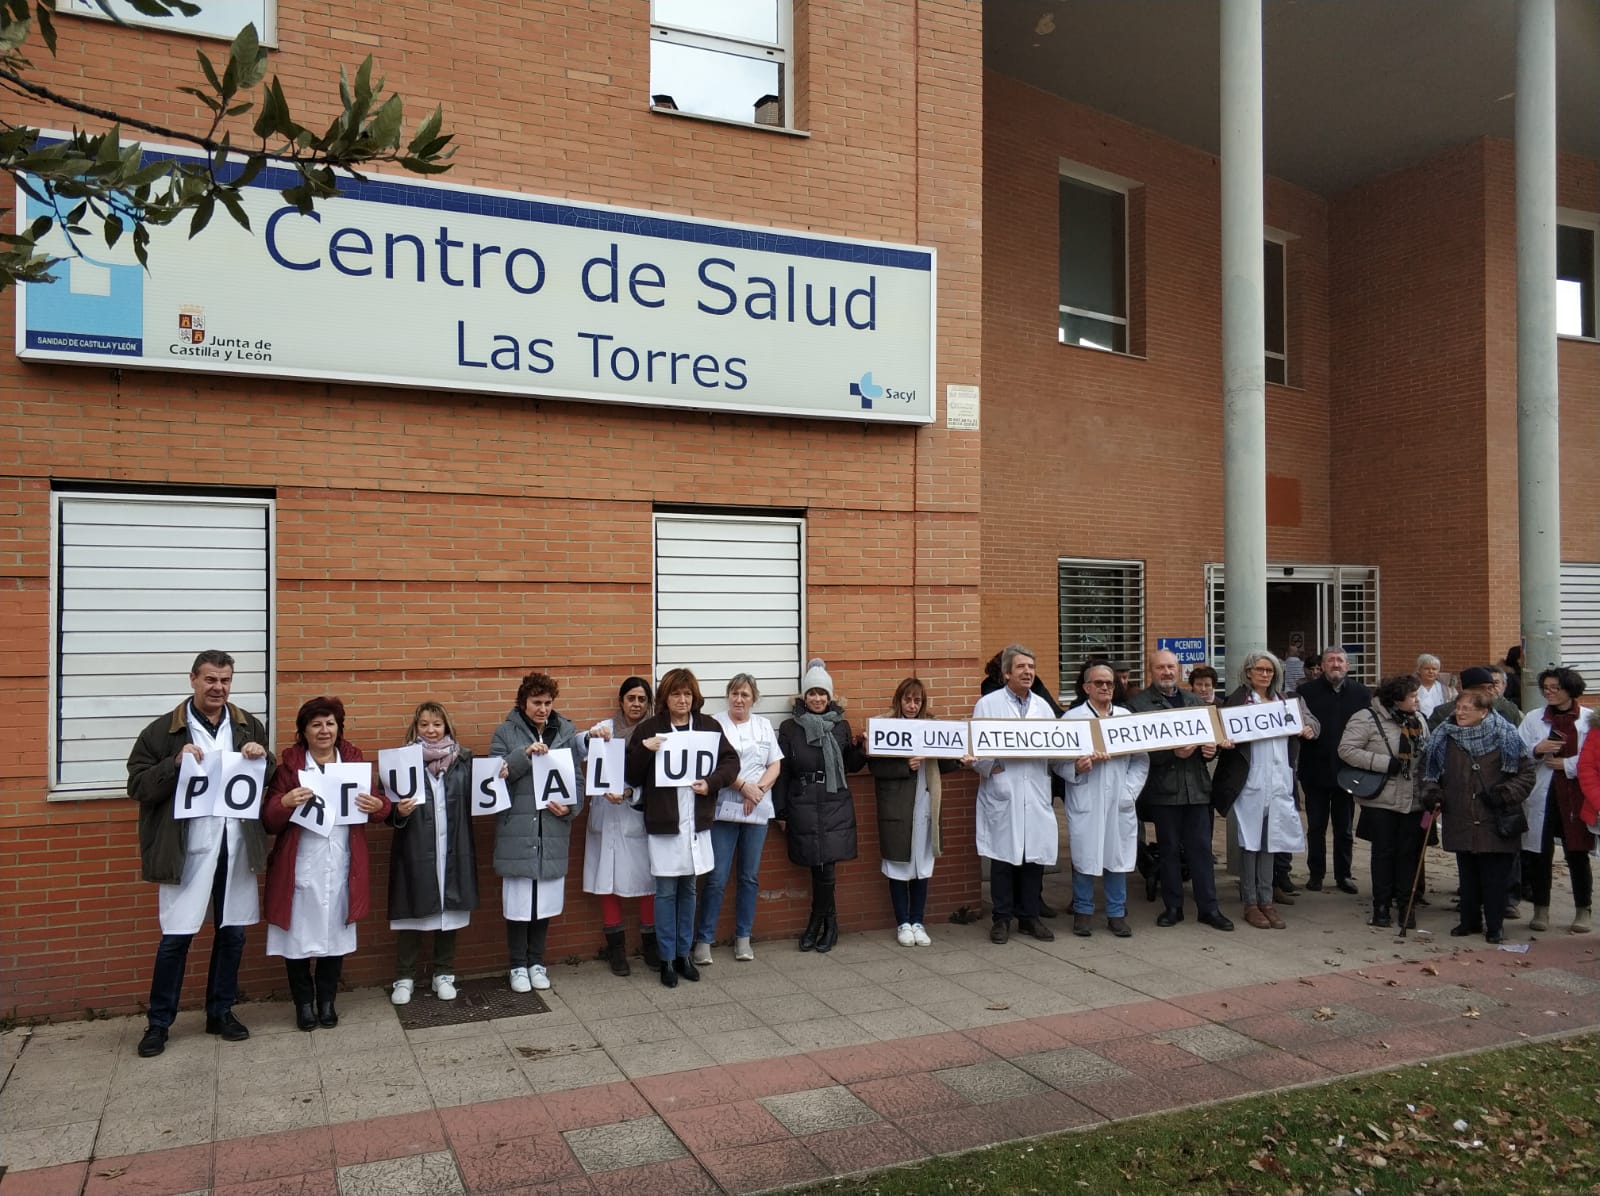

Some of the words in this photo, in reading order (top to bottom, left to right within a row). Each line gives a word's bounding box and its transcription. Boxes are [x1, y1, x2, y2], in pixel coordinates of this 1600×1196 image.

[265, 206, 546, 295] Centro
[581, 244, 666, 308] de
[697, 258, 877, 331] Salud
[37, 336, 68, 346] SANIDAD
[68, 338, 79, 347] DE
[79, 339, 111, 349] CASTILLA
[110, 342, 117, 350] Y
[117, 342, 137, 351] LEÓN
[209, 335, 250, 348] Junta
[254, 339, 272, 351] de
[169, 344, 220, 358] Castilla
[224, 350, 233, 361] y
[237, 349, 272, 361] León
[458, 320, 554, 374] Las
[578, 331, 748, 390] Torres
[886, 388, 916, 403] Sacyl
[1178, 640, 1202, 650] CENTRO
[1175, 652, 1185, 662] DE
[1185, 652, 1205, 662] SALUD
[874, 730, 913, 747] POR
[923, 730, 964, 747] UNA
[977, 726, 1080, 748] ATENCIÓN
[1107, 719, 1209, 745] PRIMARIA
